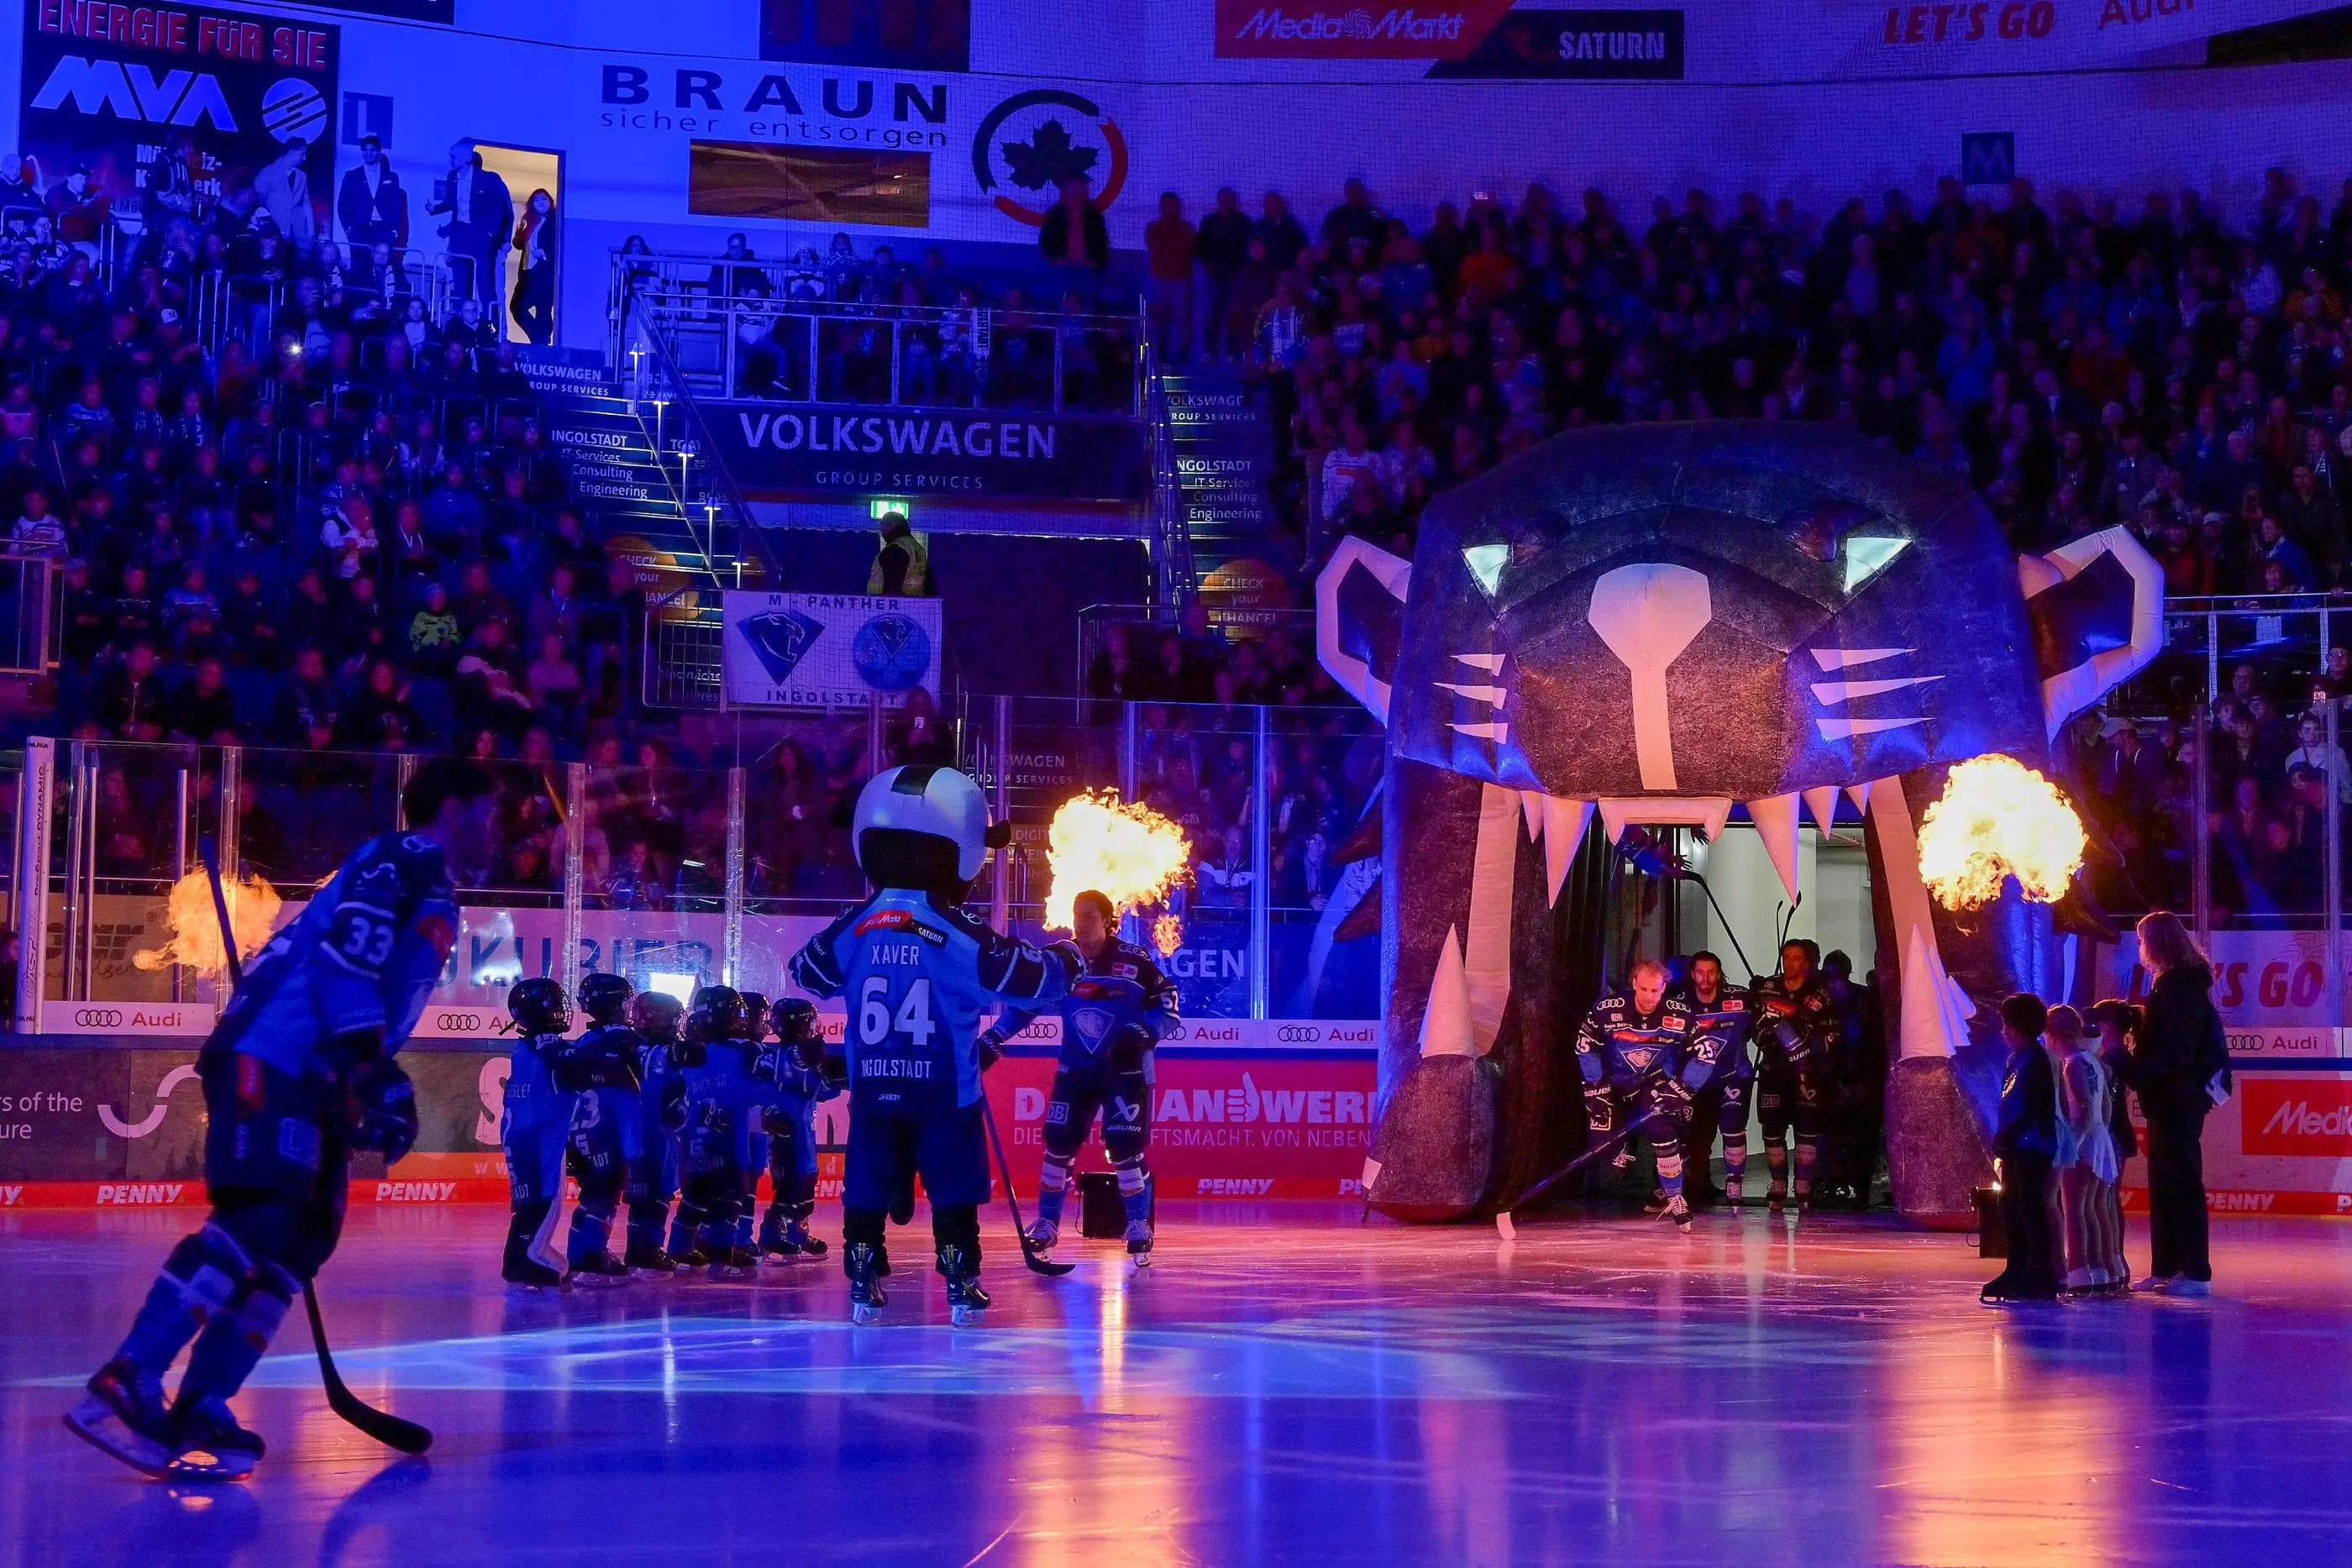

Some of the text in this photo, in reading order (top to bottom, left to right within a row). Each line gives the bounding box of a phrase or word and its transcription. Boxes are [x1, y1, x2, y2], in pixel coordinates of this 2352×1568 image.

[1883, 1, 2055, 45] LET'S GO
[38, 0, 327, 68] ENERGIE FÜR SIE
[1559, 31, 1665, 60] SATURN
[30, 55, 239, 132] MVA
[602, 65, 947, 124] BRAUN
[601, 108, 948, 149] sicher entsorgen
[513, 361, 602, 381] VOLKSWAGEN
[529, 380, 609, 396] ROUP SERVICES
[1171, 412, 1257, 422] ROUP SERVICES
[551, 429, 628, 448] INGOLSTADT
[739, 412, 1056, 459] VOLKSWAGEN
[575, 449, 621, 463] Services
[1176, 459, 1252, 472] NGOLSTADT
[573, 463, 633, 482] Consulting
[816, 470, 984, 490] GROUP SERVICES
[580, 481, 648, 501] Engineering
[1189, 507, 1263, 522] Engineering
[633, 572, 659, 584] your
[769, 595, 900, 611] M PANTHER
[1016, 774, 1074, 784] SERVICES
[344, 917, 395, 967] 33
[917, 926, 944, 945] SATURN
[871, 945, 921, 967] XAVER
[2259, 961, 2323, 1008] GO
[131, 1011, 182, 1027] Audi
[859, 975, 936, 1046] 64
[818, 1022, 844, 1036] udi
[1194, 1026, 1240, 1041] Audi
[1328, 1027, 1375, 1041] Audi
[1693, 1040, 1714, 1059] 25
[2271, 1035, 2318, 1051] Audi
[19, 1092, 43, 1112] of
[47, 1092, 83, 1113] the
[0, 1123, 32, 1140] ure
[1014, 1127, 1042, 1146] DIE
[1262, 1129, 1300, 1147] VON
[96, 1184, 182, 1204] PENNY
[375, 1182, 459, 1201] PENNY
[1197, 1177, 1275, 1195] PENNY
